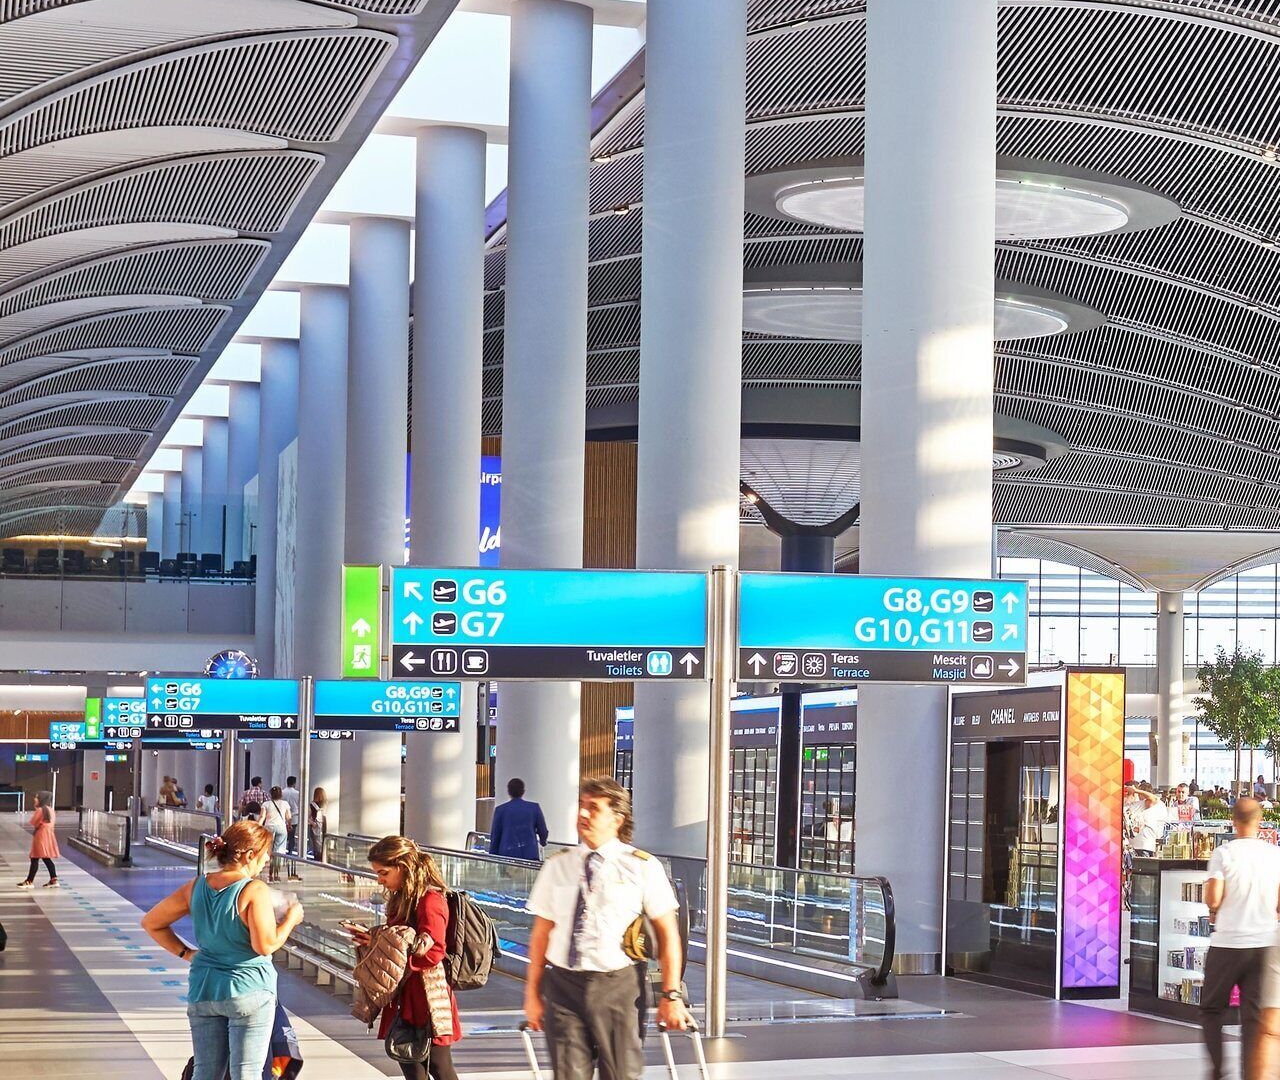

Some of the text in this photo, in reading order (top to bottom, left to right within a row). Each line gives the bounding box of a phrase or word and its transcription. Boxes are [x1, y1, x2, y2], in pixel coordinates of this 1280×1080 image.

[462, 579, 507, 605] G6
[883, 588, 969, 617] G8,G9
[461, 612, 505, 637] G7
[855, 617, 968, 647] G10,G11
[587, 650, 643, 663] Tuvaletler
[831, 653, 860, 664] Teras
[933, 654, 967, 666] Mescit
[606, 664, 643, 677] Toilets
[831, 667, 870, 678] Terrace
[933, 668, 967, 681] Masjid
[179, 683, 202, 695] G6
[385, 686, 431, 700] G8,G9
[179, 698, 201, 711] G7
[371, 701, 431, 715] G10,G11
[990, 708, 1016, 725] CHANEL
